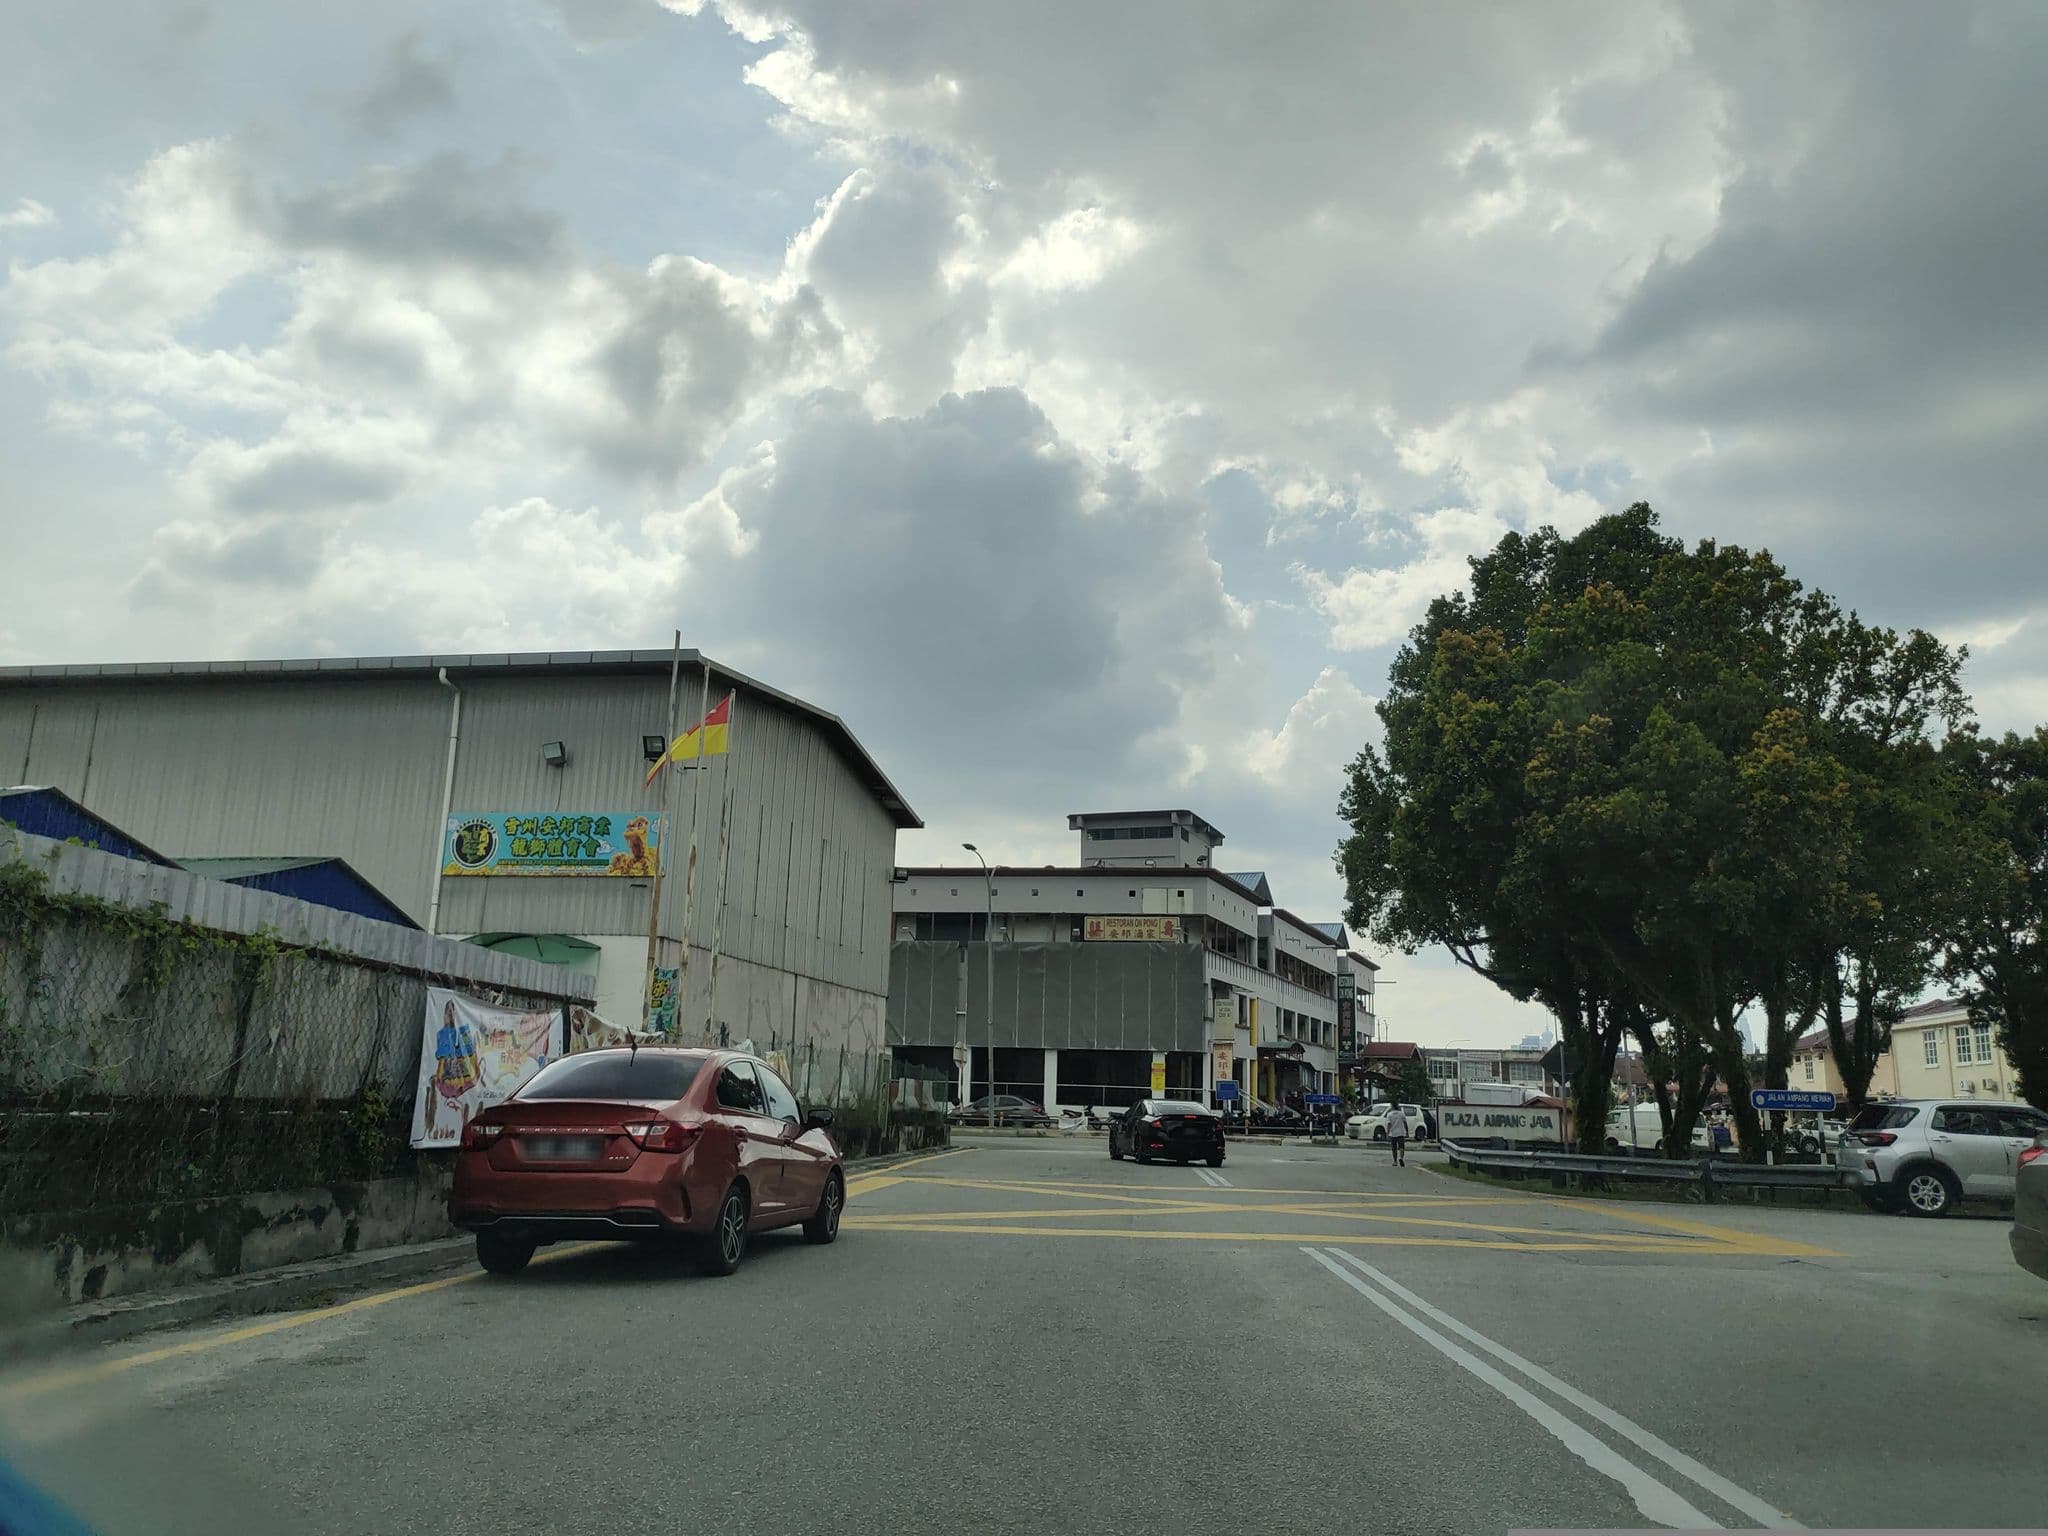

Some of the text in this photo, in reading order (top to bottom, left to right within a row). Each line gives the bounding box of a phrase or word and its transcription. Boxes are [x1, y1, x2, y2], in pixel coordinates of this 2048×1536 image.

[1106, 918, 1158, 928] RESTORAN ON PONG
[1768, 1092, 1786, 1101] JALAN
[1787, 1094, 1809, 1102] AMPANG
[1445, 1113, 1554, 1129] PLAZA AMPANG JAYA
